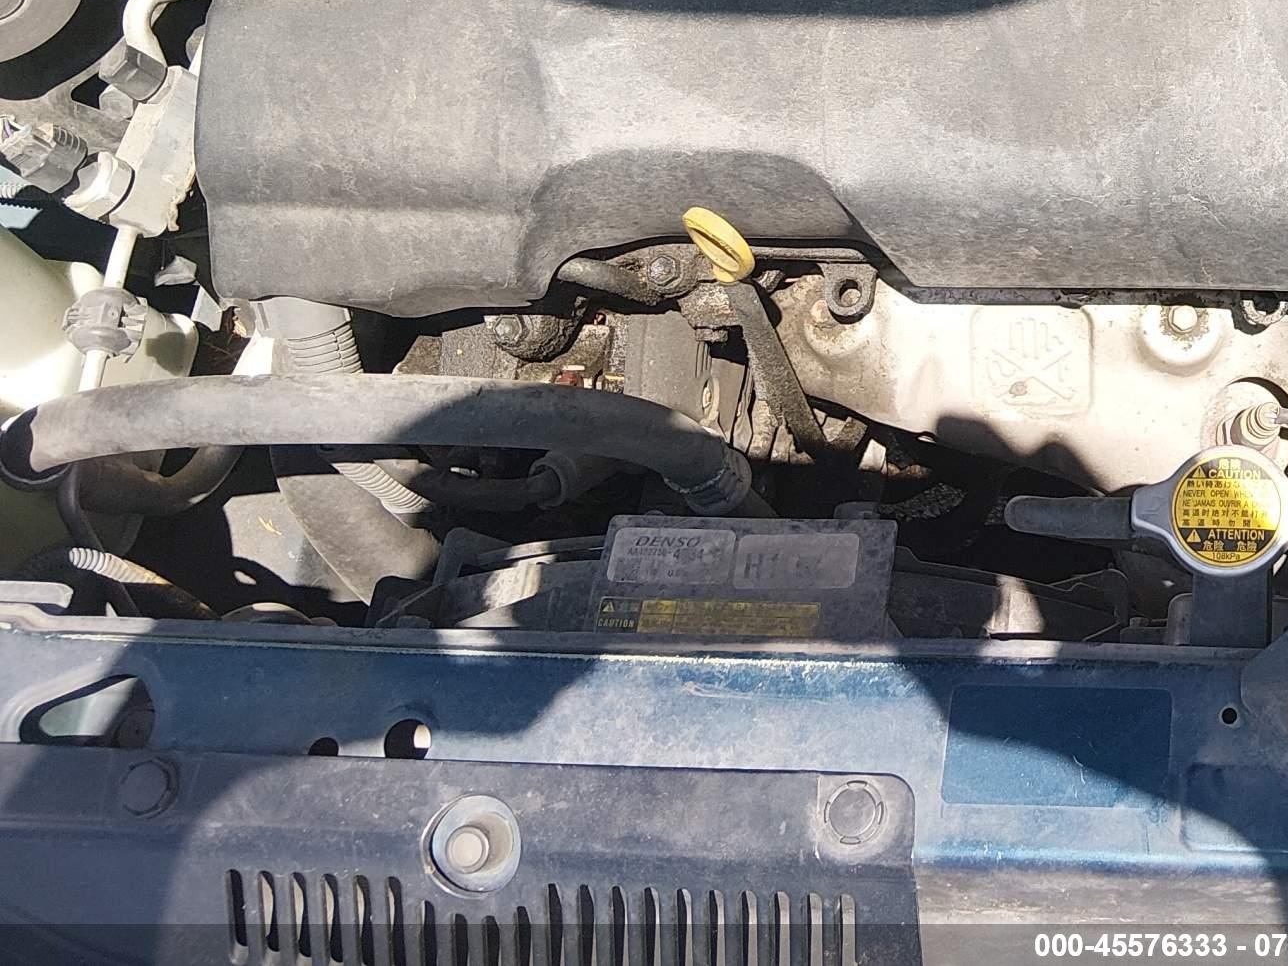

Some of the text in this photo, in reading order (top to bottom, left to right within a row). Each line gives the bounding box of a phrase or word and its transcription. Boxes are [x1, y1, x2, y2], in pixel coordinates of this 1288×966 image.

[1208, 469, 1261, 480] CAUTION
[1183, 489, 1206, 498] NEVER
[1210, 489, 1230, 498] OPEN
[1182, 498, 1192, 507] NE
[1193, 499, 1216, 507] JAMAIS
[1218, 499, 1242, 508] OUVRIR
[1208, 529, 1265, 541] ATTENTION
[635, 535, 701, 548] DENSO
[1212, 552, 1241, 561] 108kPa
[597, 617, 635, 629] CAUTION
